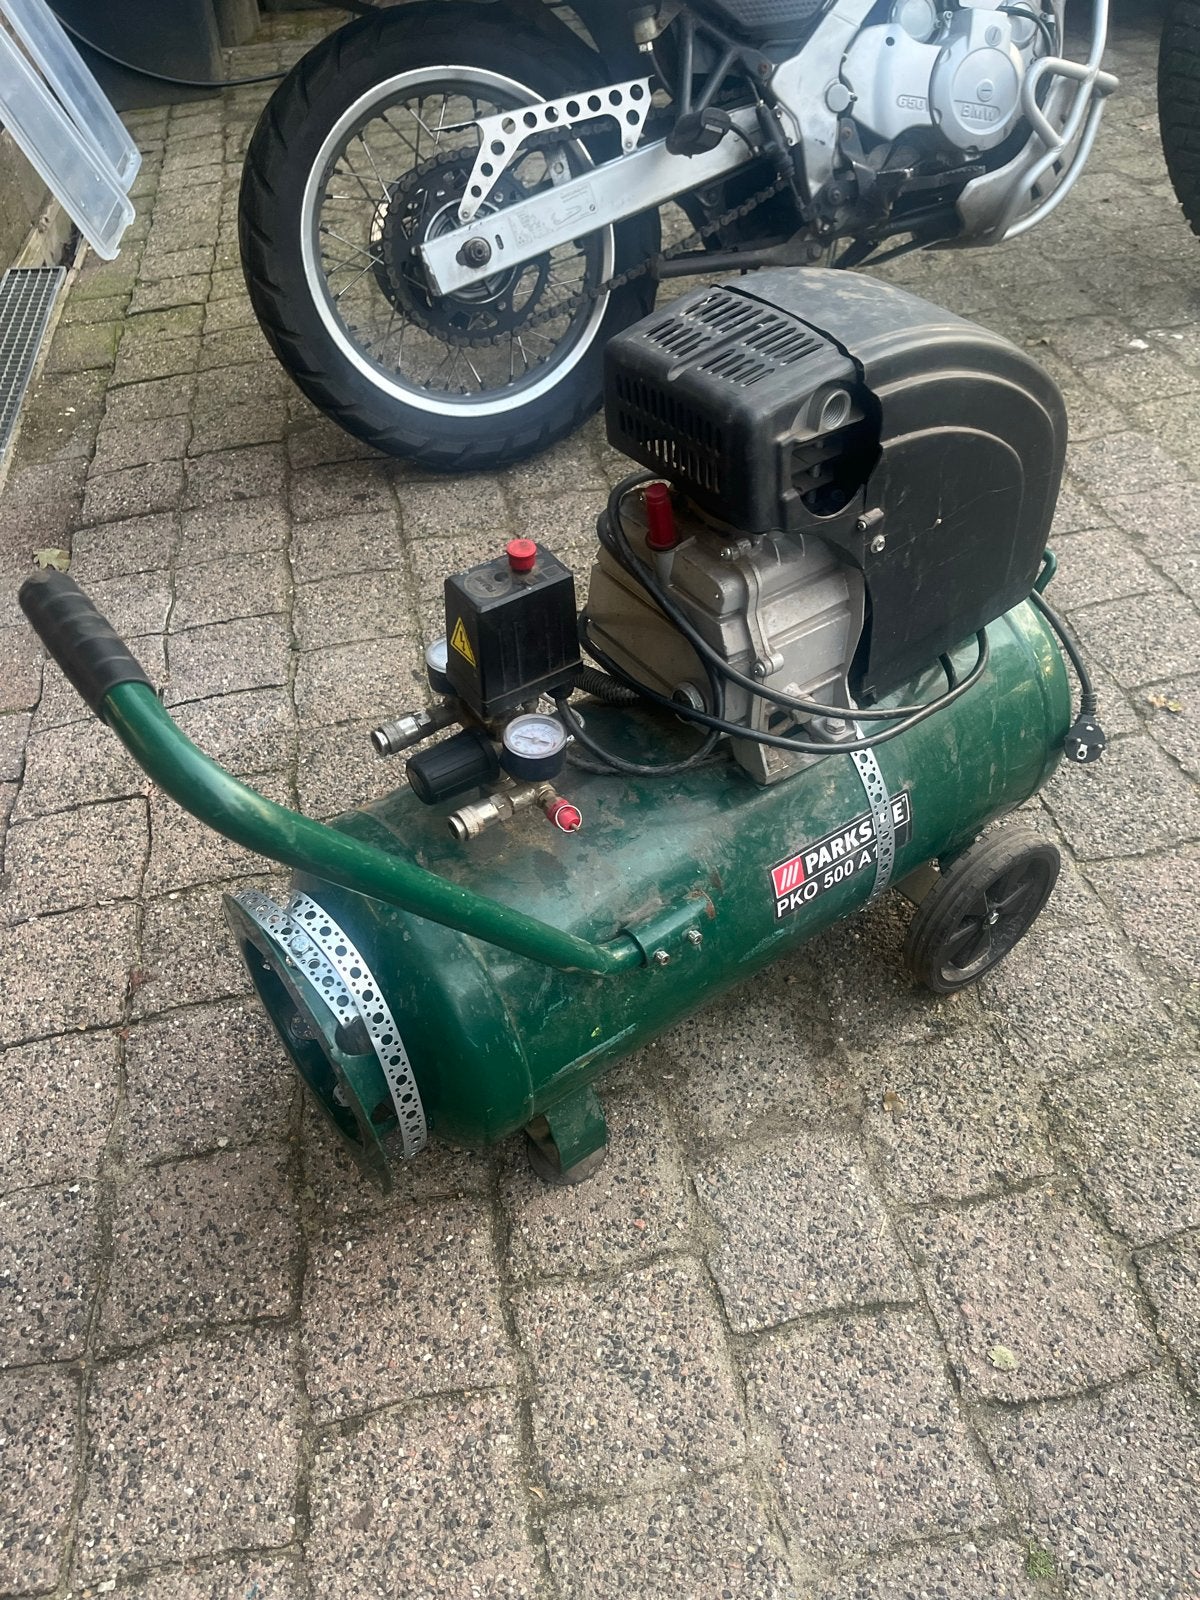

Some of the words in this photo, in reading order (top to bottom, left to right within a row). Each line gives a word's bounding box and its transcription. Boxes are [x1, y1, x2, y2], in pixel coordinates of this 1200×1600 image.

[897, 96, 926, 110] 650
[961, 104, 994, 121] BMW
[776, 881, 818, 918] PKO
[823, 859, 854, 889] 500
